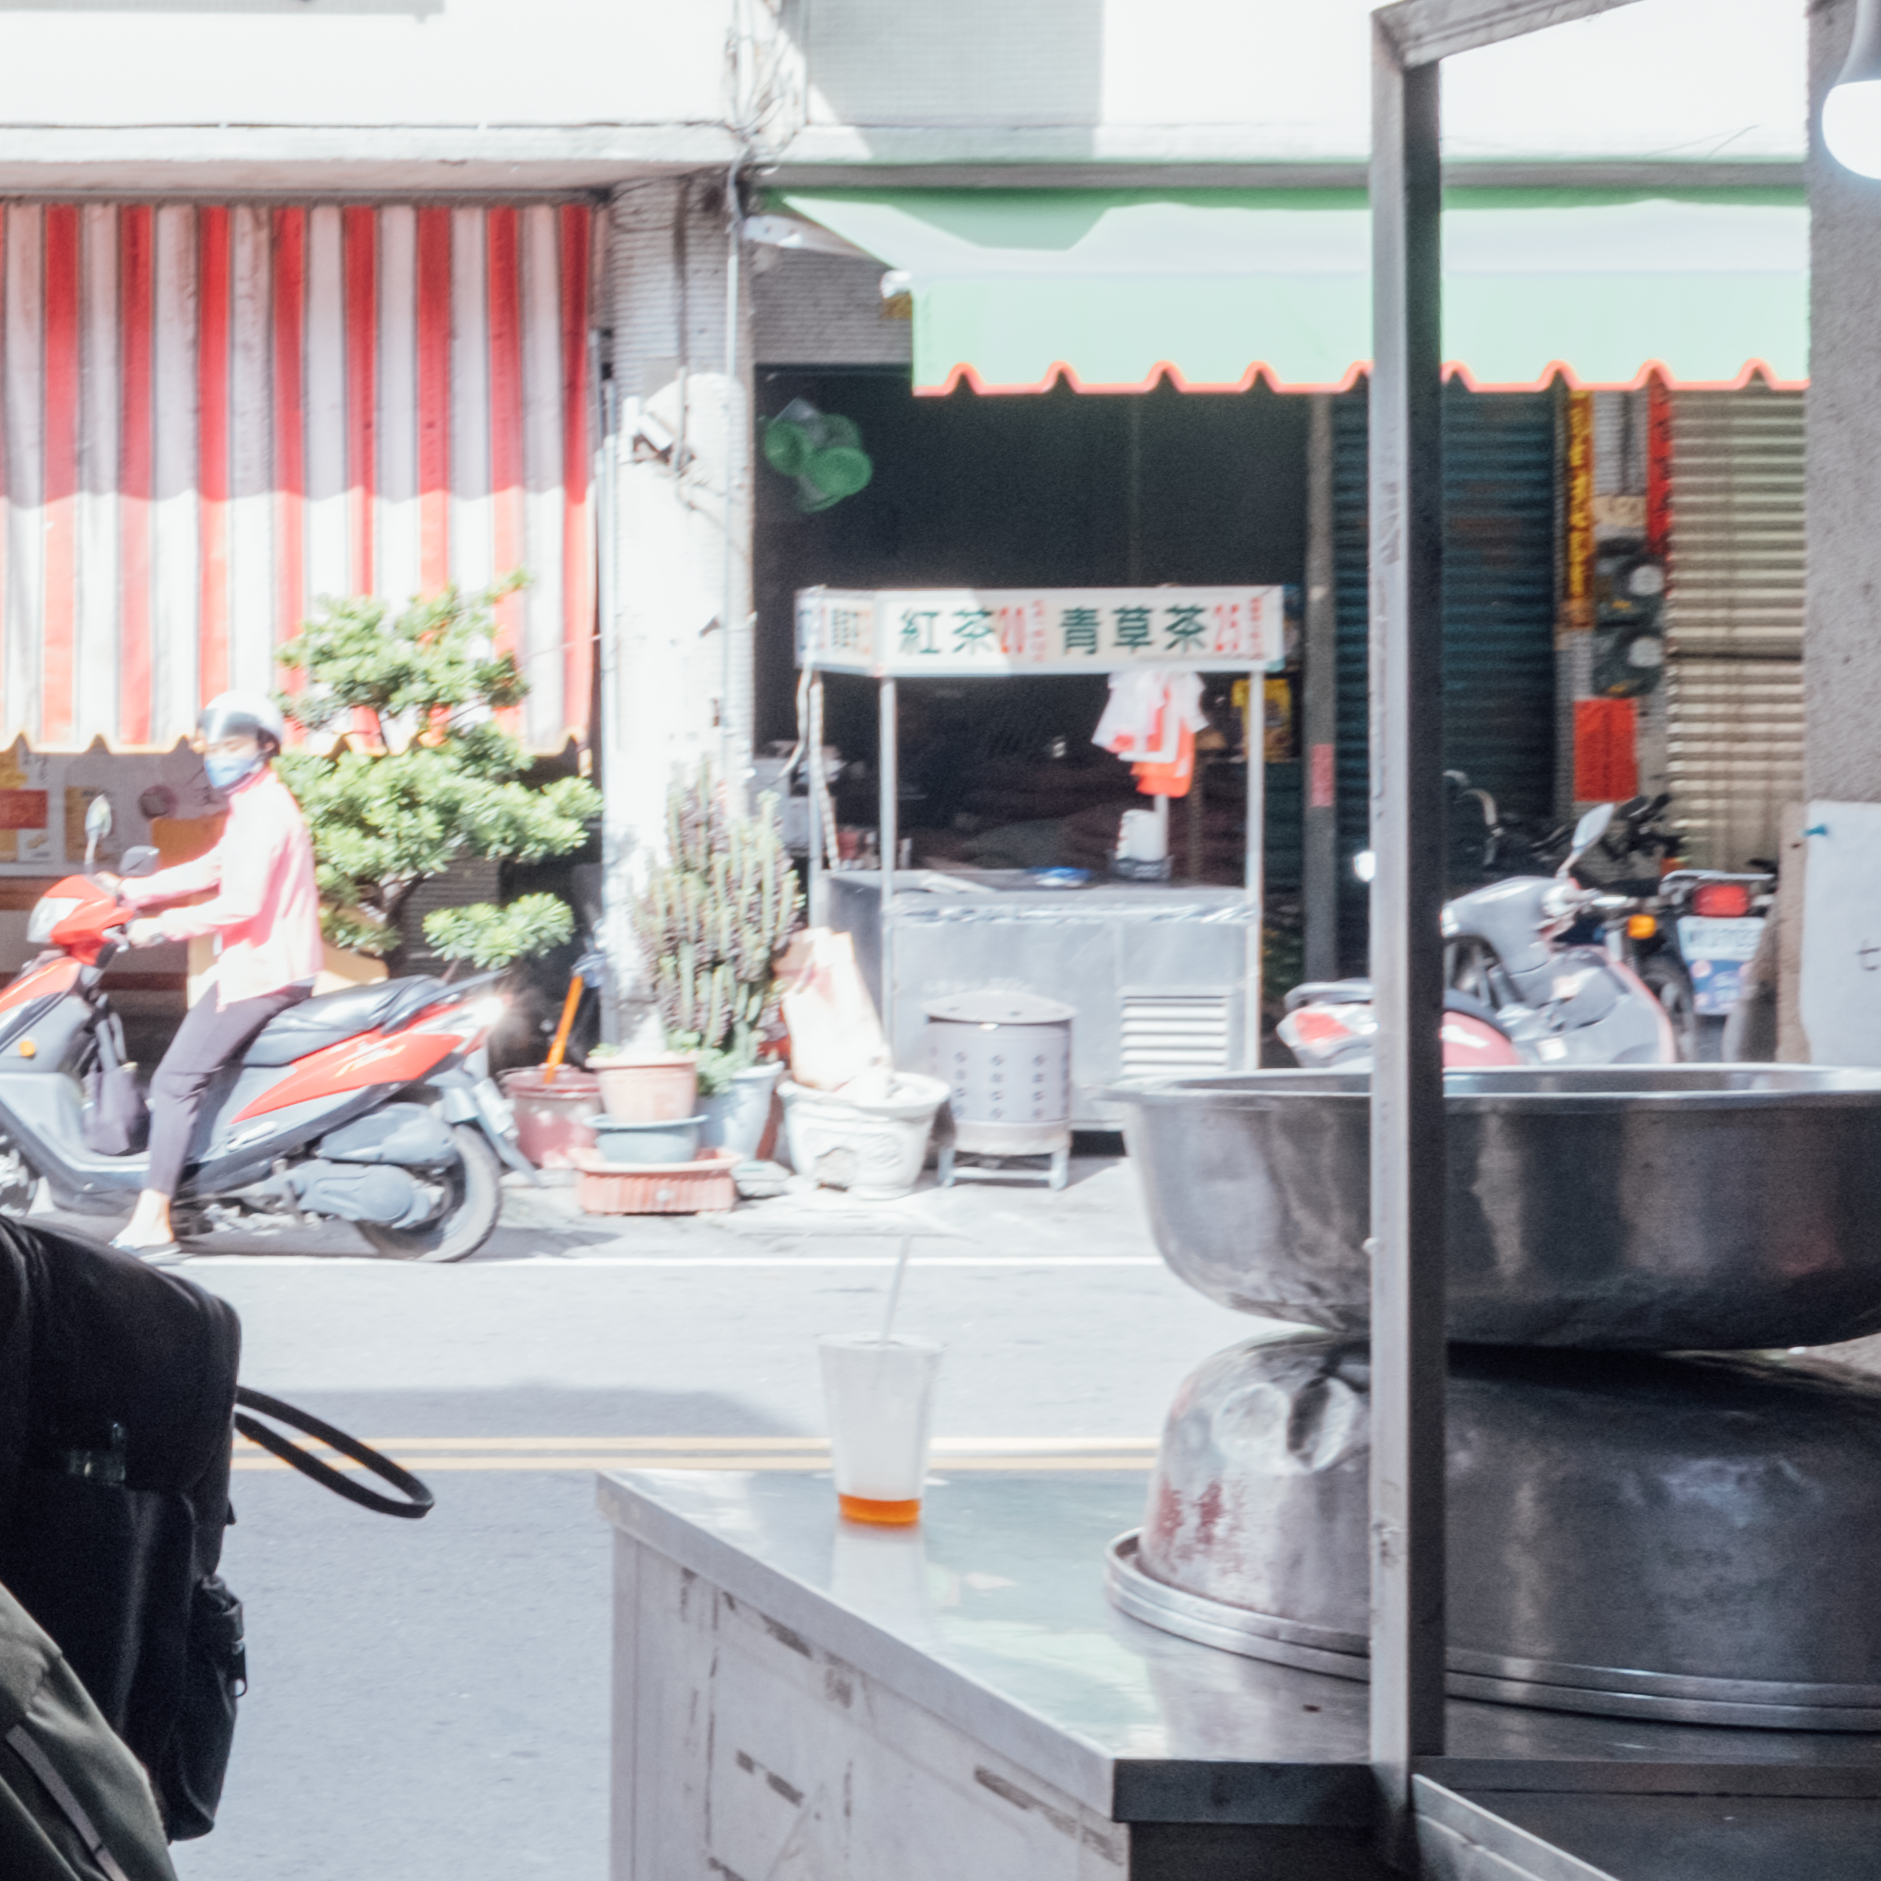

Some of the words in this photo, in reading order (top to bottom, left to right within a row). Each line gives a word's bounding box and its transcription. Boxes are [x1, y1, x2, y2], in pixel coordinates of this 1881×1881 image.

[899, 606, 995, 656] 紅茶
[1059, 604, 1208, 656] 青草茶
